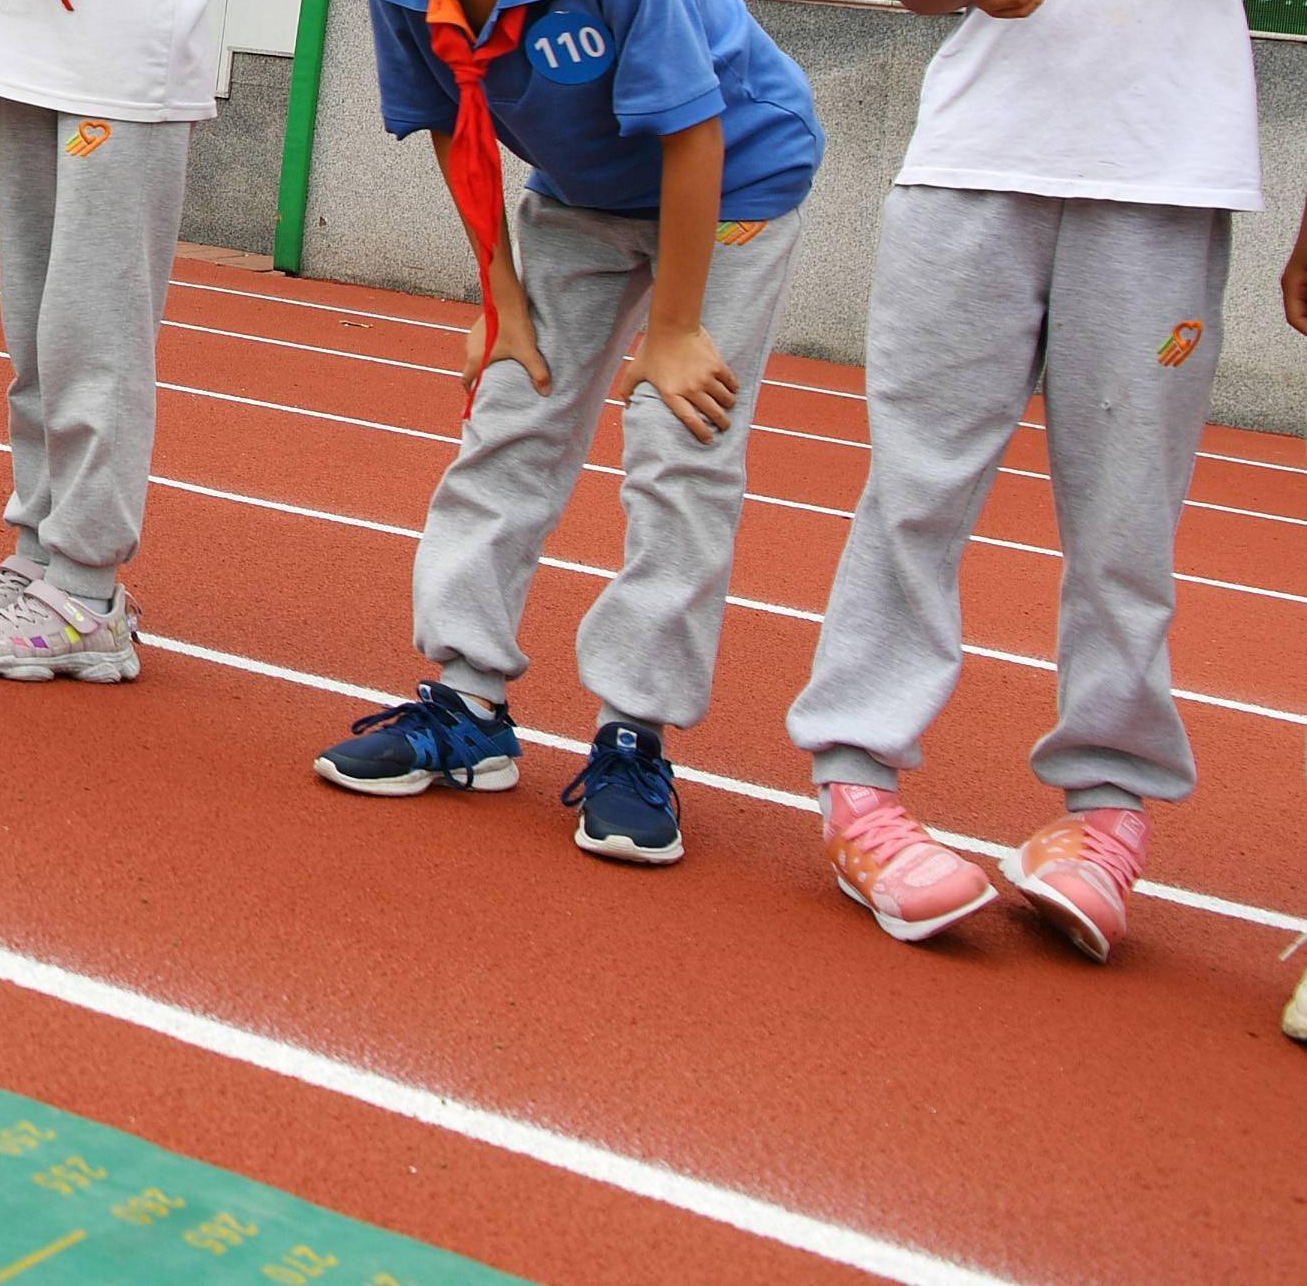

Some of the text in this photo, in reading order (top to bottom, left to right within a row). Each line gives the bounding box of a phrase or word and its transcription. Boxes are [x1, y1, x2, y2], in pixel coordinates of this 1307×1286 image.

[533, 25, 606, 69] 110
[32, 1154, 108, 1197] 255
[180, 1211, 259, 1255] 265
[260, 1243, 338, 1286] 270
